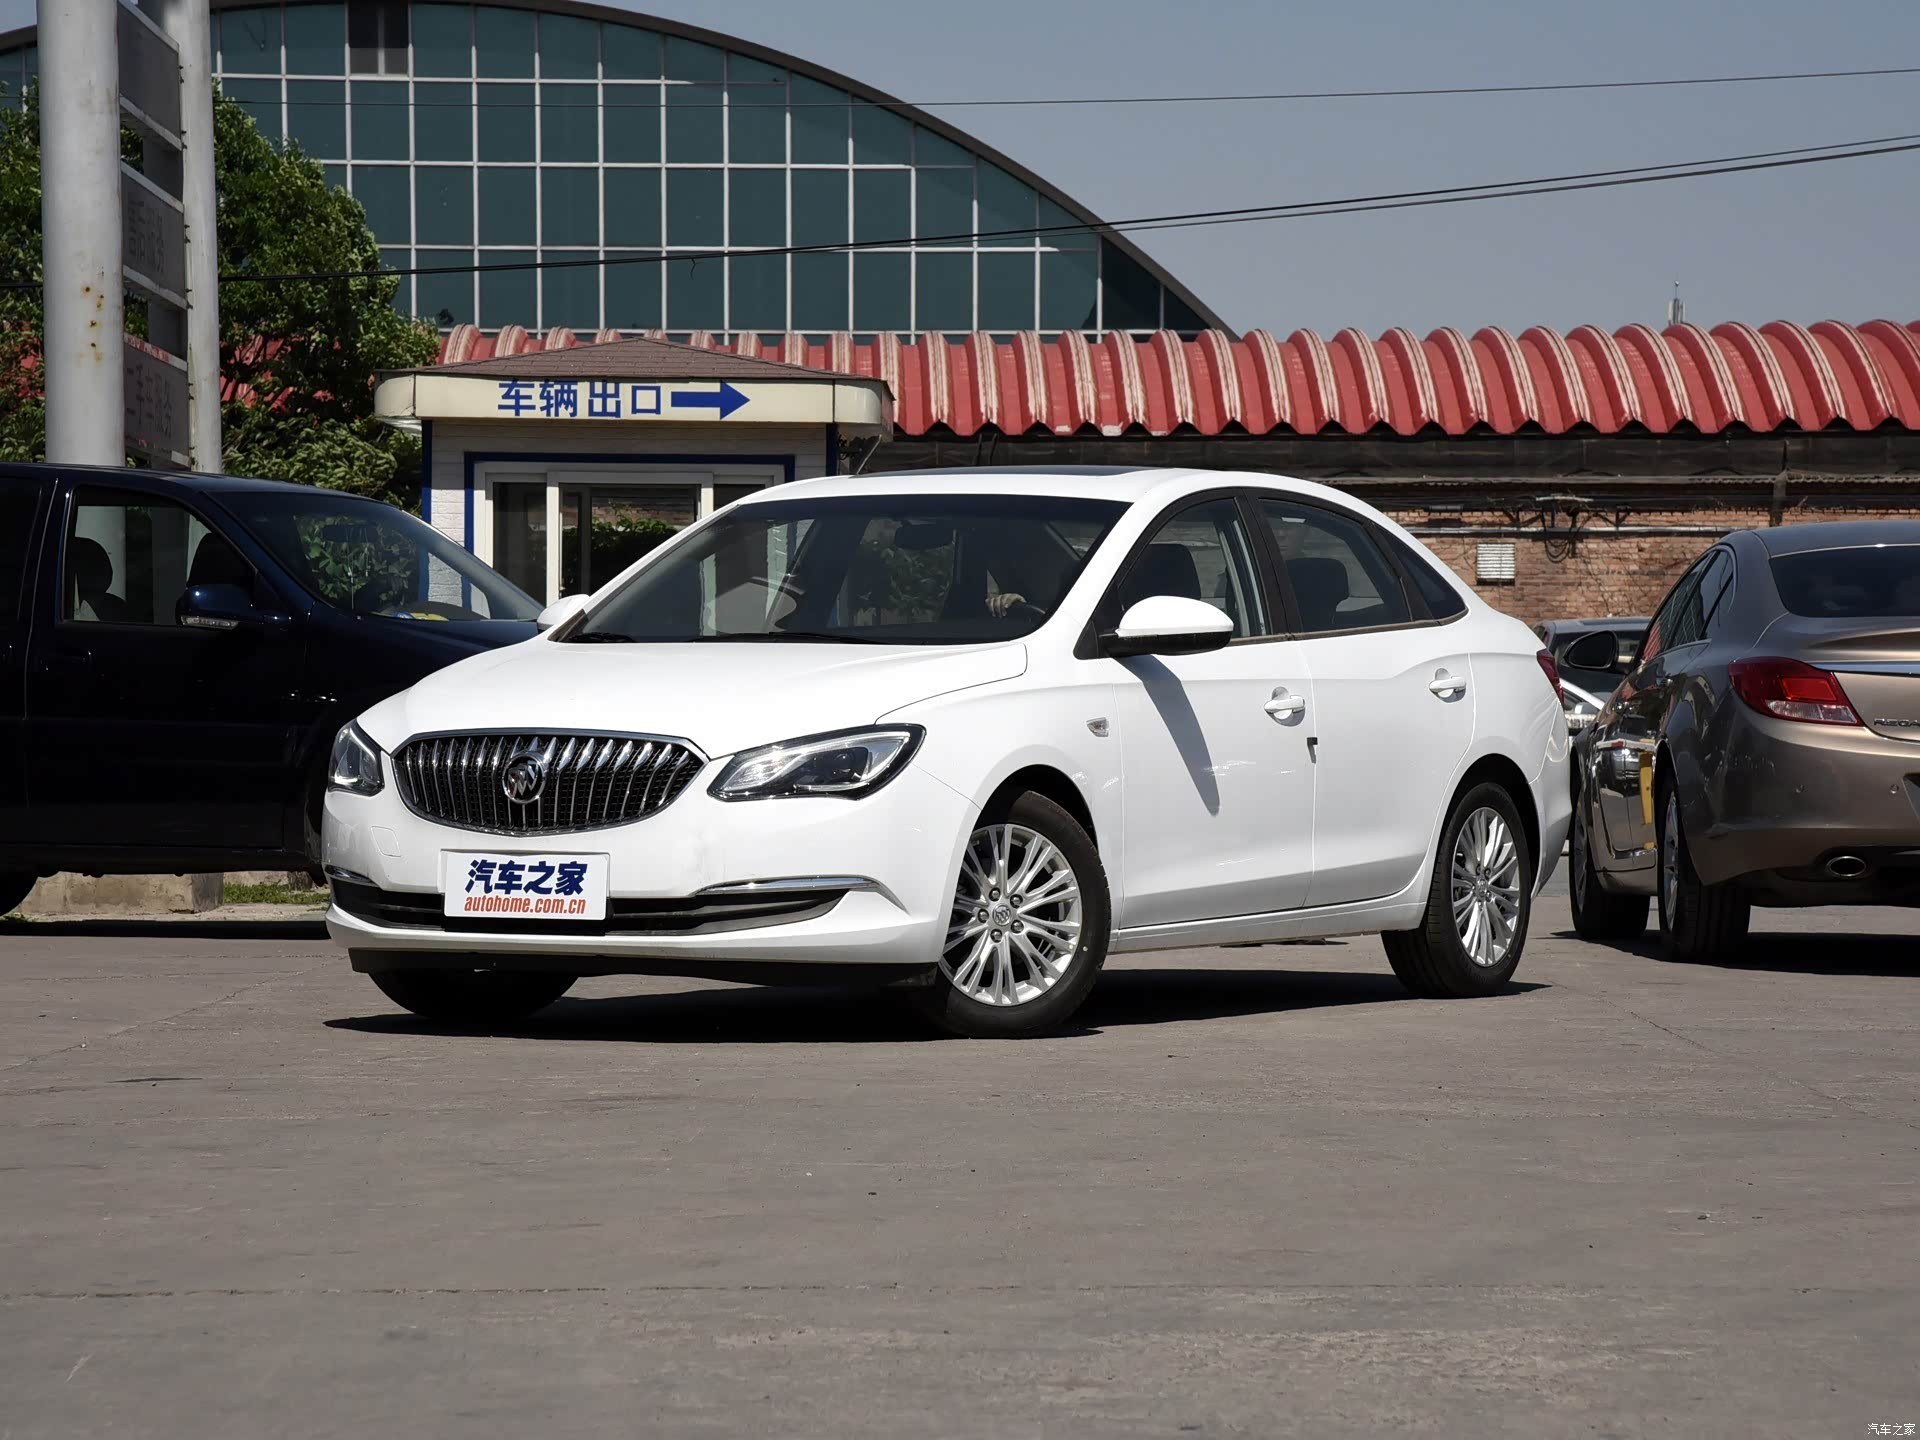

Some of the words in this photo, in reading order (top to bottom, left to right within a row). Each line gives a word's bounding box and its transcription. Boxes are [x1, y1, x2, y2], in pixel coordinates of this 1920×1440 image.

[498, 378, 661, 418] 车辆出口
[464, 859, 588, 896] 汽车之家
[464, 895, 587, 914] autohome.com.cn
